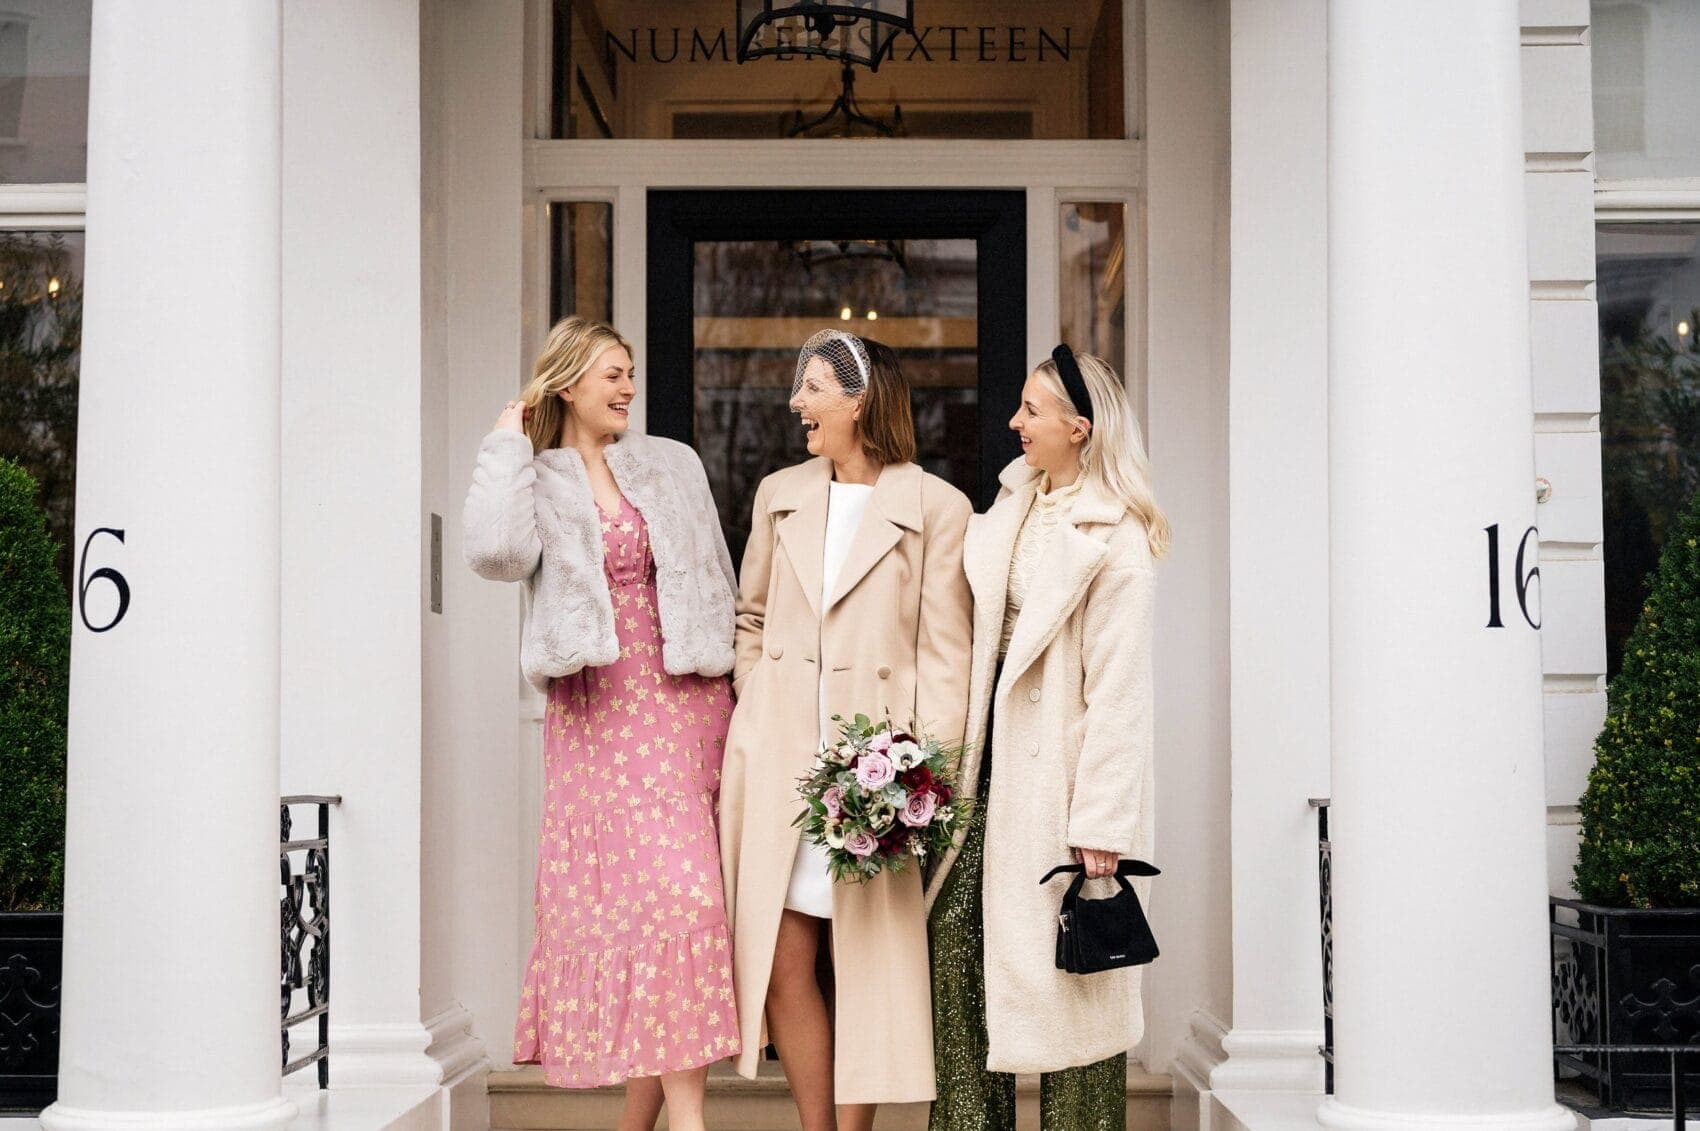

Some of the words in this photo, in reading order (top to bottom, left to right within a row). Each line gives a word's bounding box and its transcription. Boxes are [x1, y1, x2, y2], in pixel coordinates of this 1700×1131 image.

[858, 26, 1071, 62] SIXTEEN
[79, 527, 131, 633] 6
[1482, 523, 1542, 631] 16
